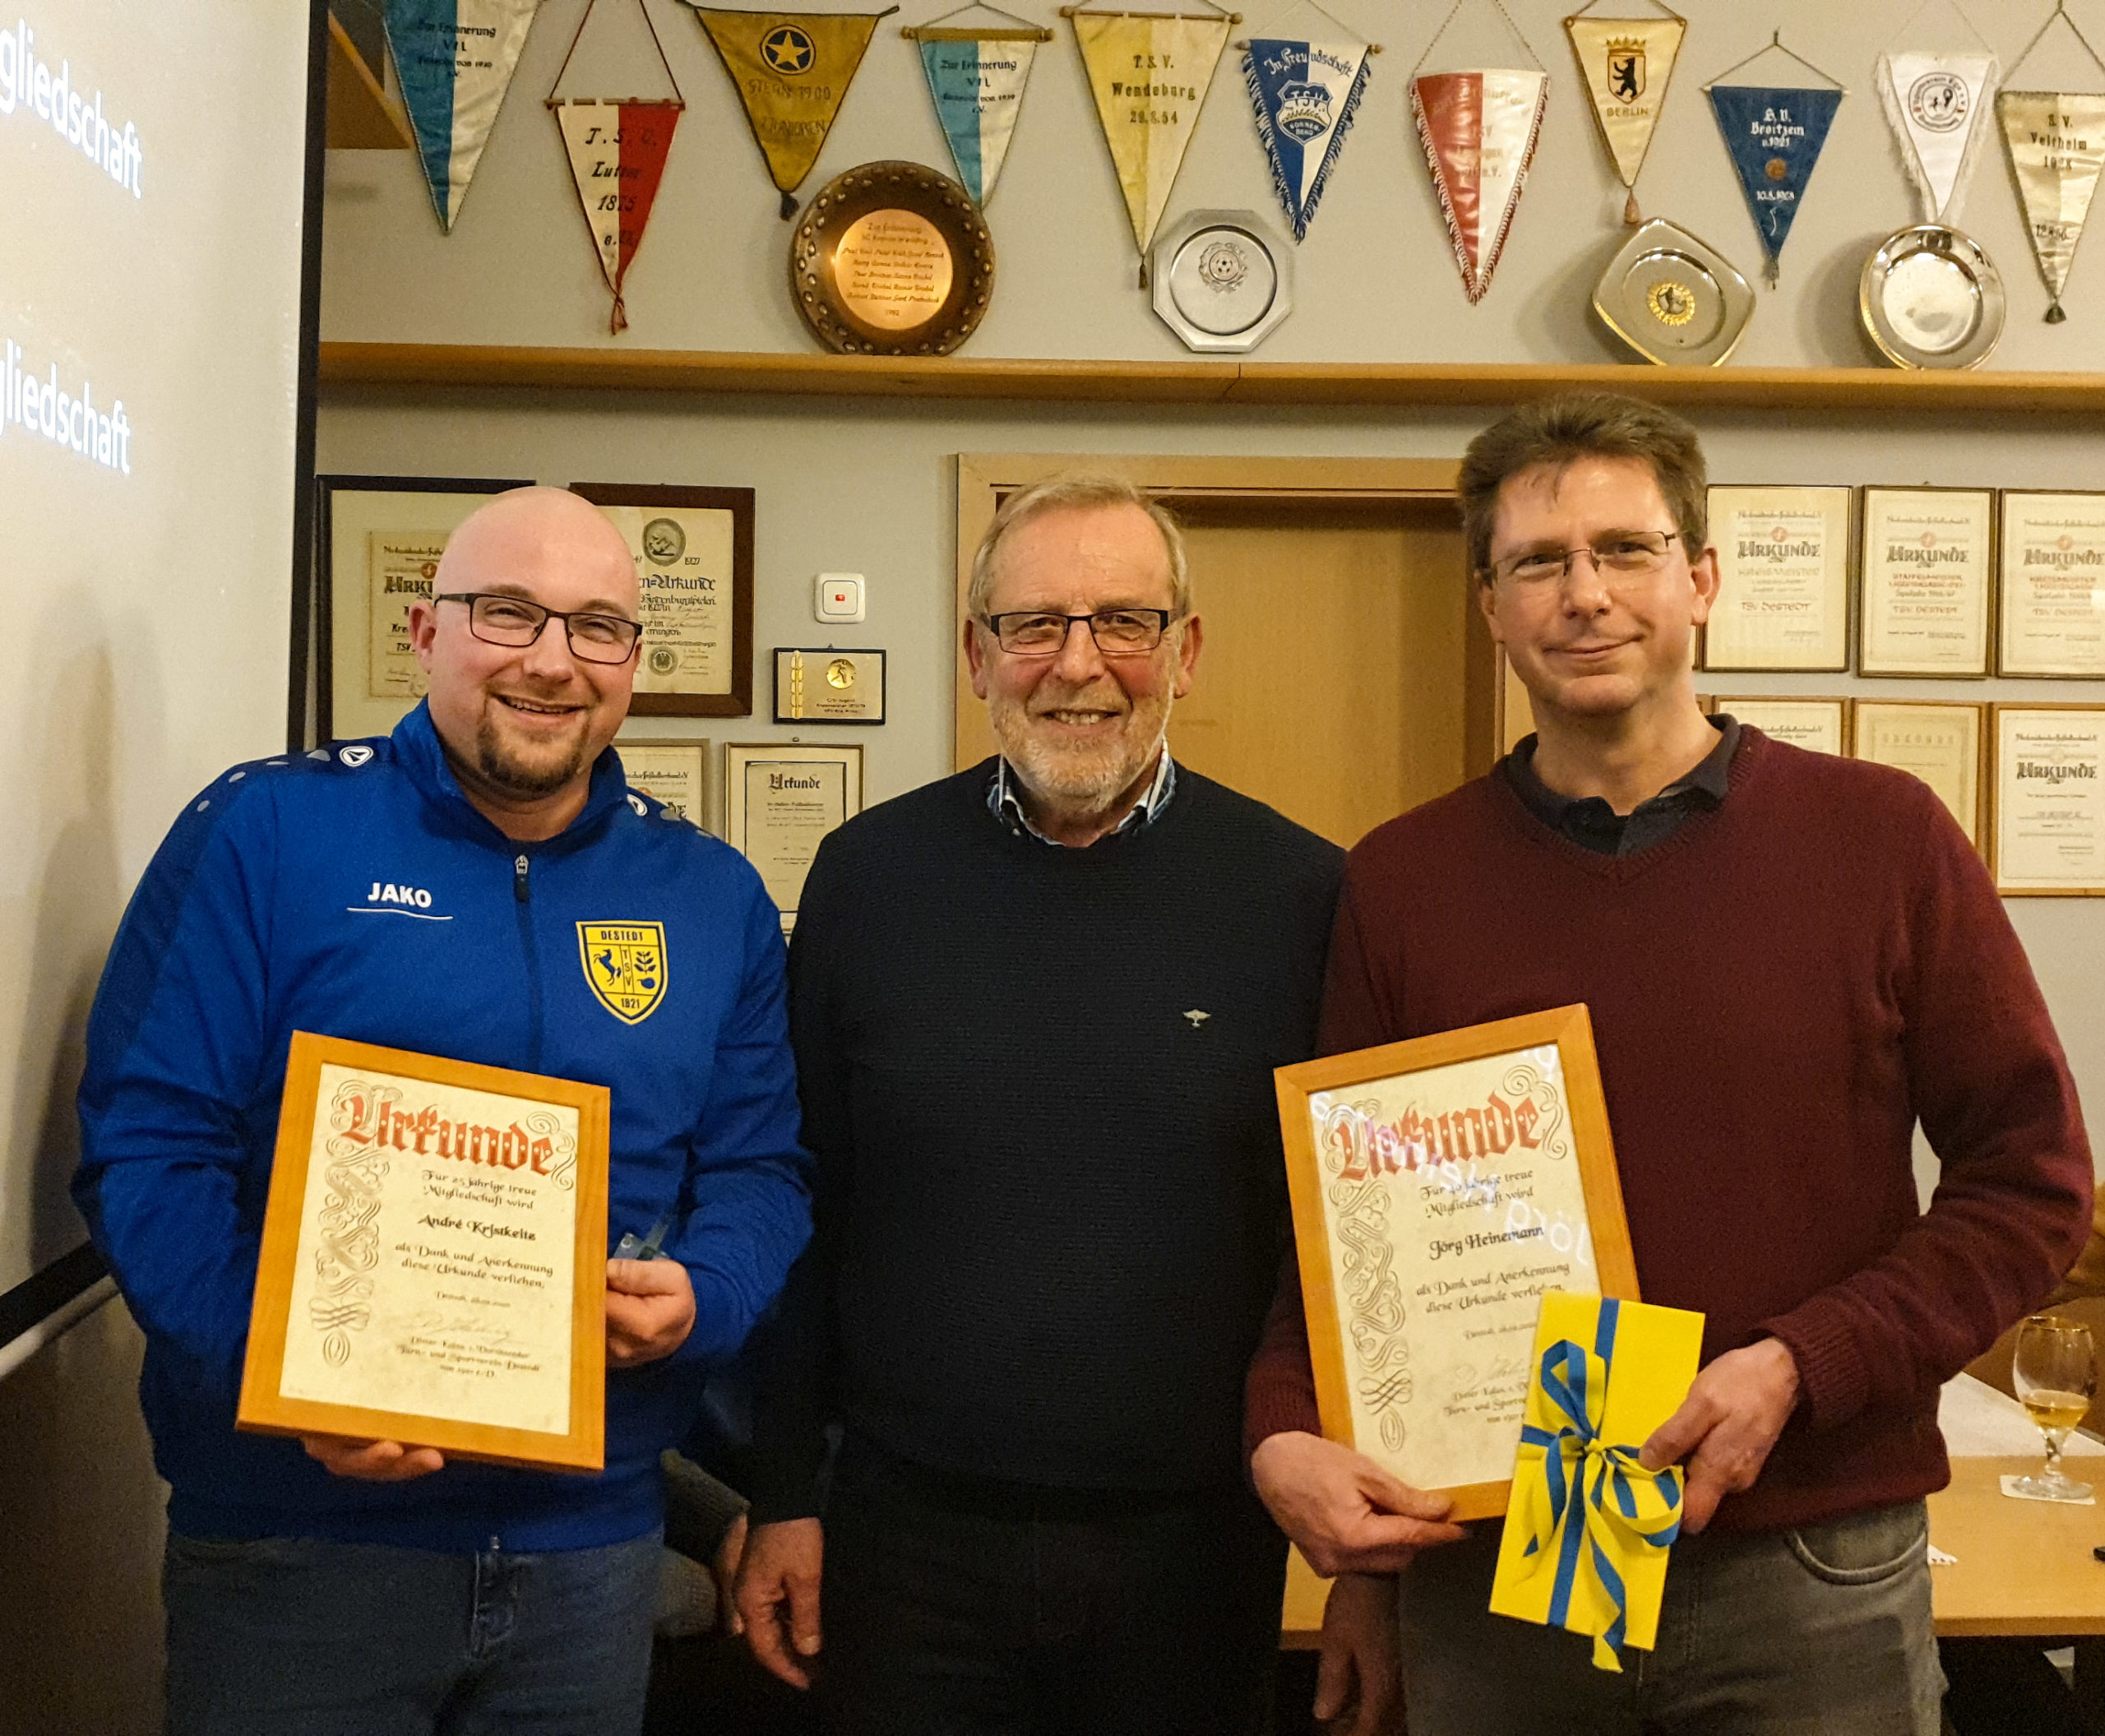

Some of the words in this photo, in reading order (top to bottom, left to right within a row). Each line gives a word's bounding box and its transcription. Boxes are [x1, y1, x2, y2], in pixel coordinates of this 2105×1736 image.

[961, 60, 1017, 71] Erinnerung
[1112, 81, 1196, 100] Wendeburg
[1606, 107, 1649, 117] BERLIN
[368, 882, 433, 908] JAKO
[601, 930, 644, 942] DESTEDT
[339, 1094, 557, 1177] Urkunde
[1329, 1089, 1546, 1182] Urkunde
[1504, 1169, 1534, 1183] treue
[423, 1185, 504, 1208] Mitgliedschaft
[507, 1199, 534, 1211] wird
[508, 1183, 538, 1197] treue
[1506, 1186, 1534, 1201] wird
[417, 1213, 463, 1230] André
[1464, 1225, 1544, 1250] Heinemann
[395, 1242, 411, 1253] als
[414, 1244, 449, 1259] Dank
[453, 1251, 474, 1264] und
[478, 1255, 554, 1278] Anerkennung
[401, 1257, 430, 1271] diese
[433, 1262, 487, 1280] Urkunde
[1416, 1284, 1432, 1296] als
[1433, 1277, 1469, 1296] Dank
[1470, 1272, 1492, 1287] und
[1495, 1262, 1571, 1285] Anerkennung
[1459, 1289, 1507, 1311] Urkunde
